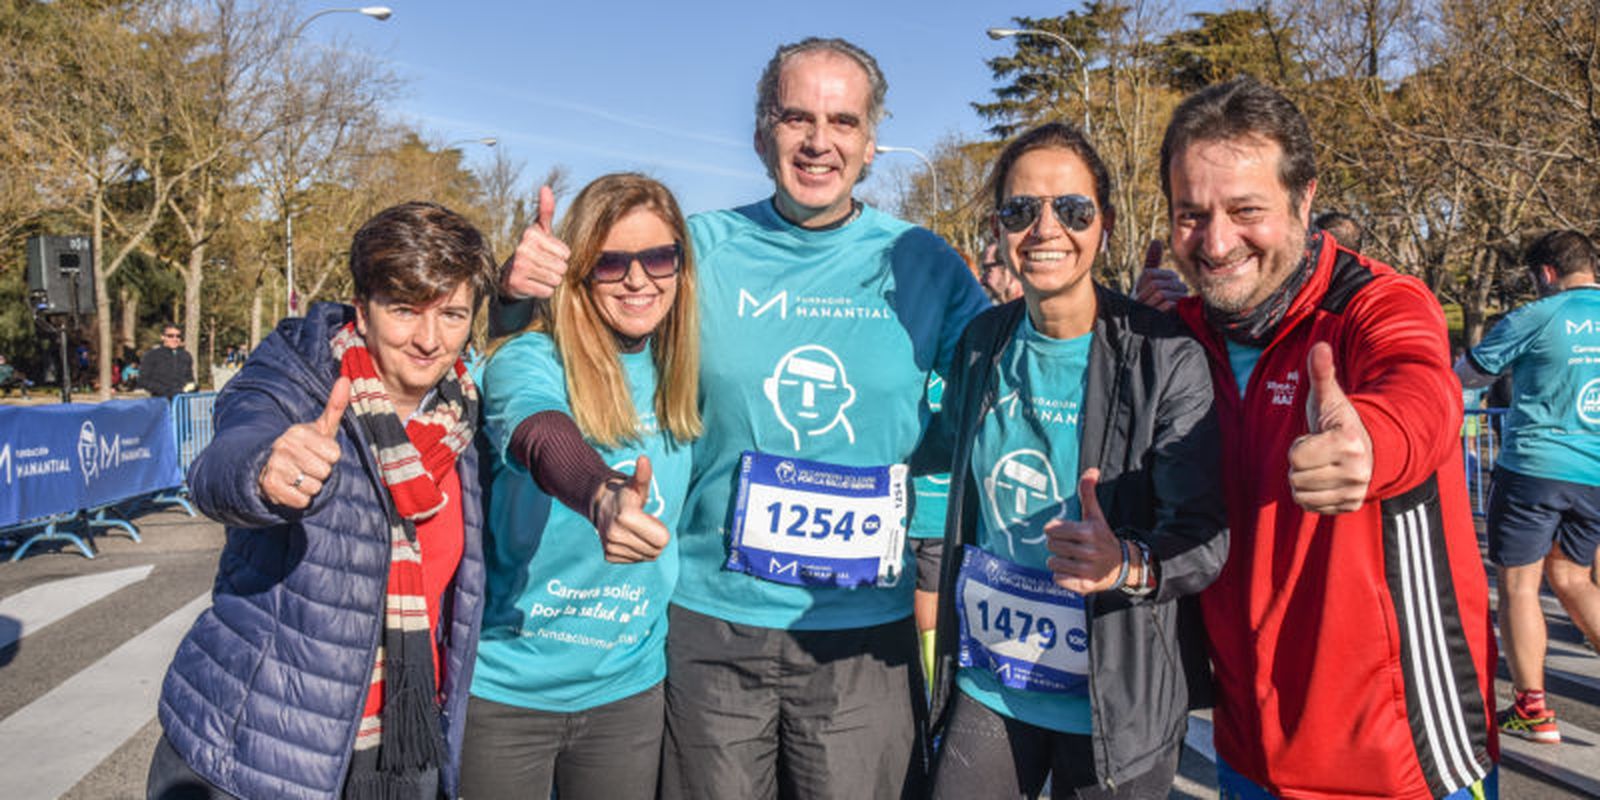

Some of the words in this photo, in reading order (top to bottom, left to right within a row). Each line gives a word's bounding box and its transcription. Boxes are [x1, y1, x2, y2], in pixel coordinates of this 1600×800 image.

[796, 306, 890, 320] MANANTIAL
[766, 501, 855, 542] 1254
[547, 579, 600, 600] Carrera
[530, 603, 560, 617] por
[578, 602, 619, 621] salud
[976, 600, 1057, 650] 1479
